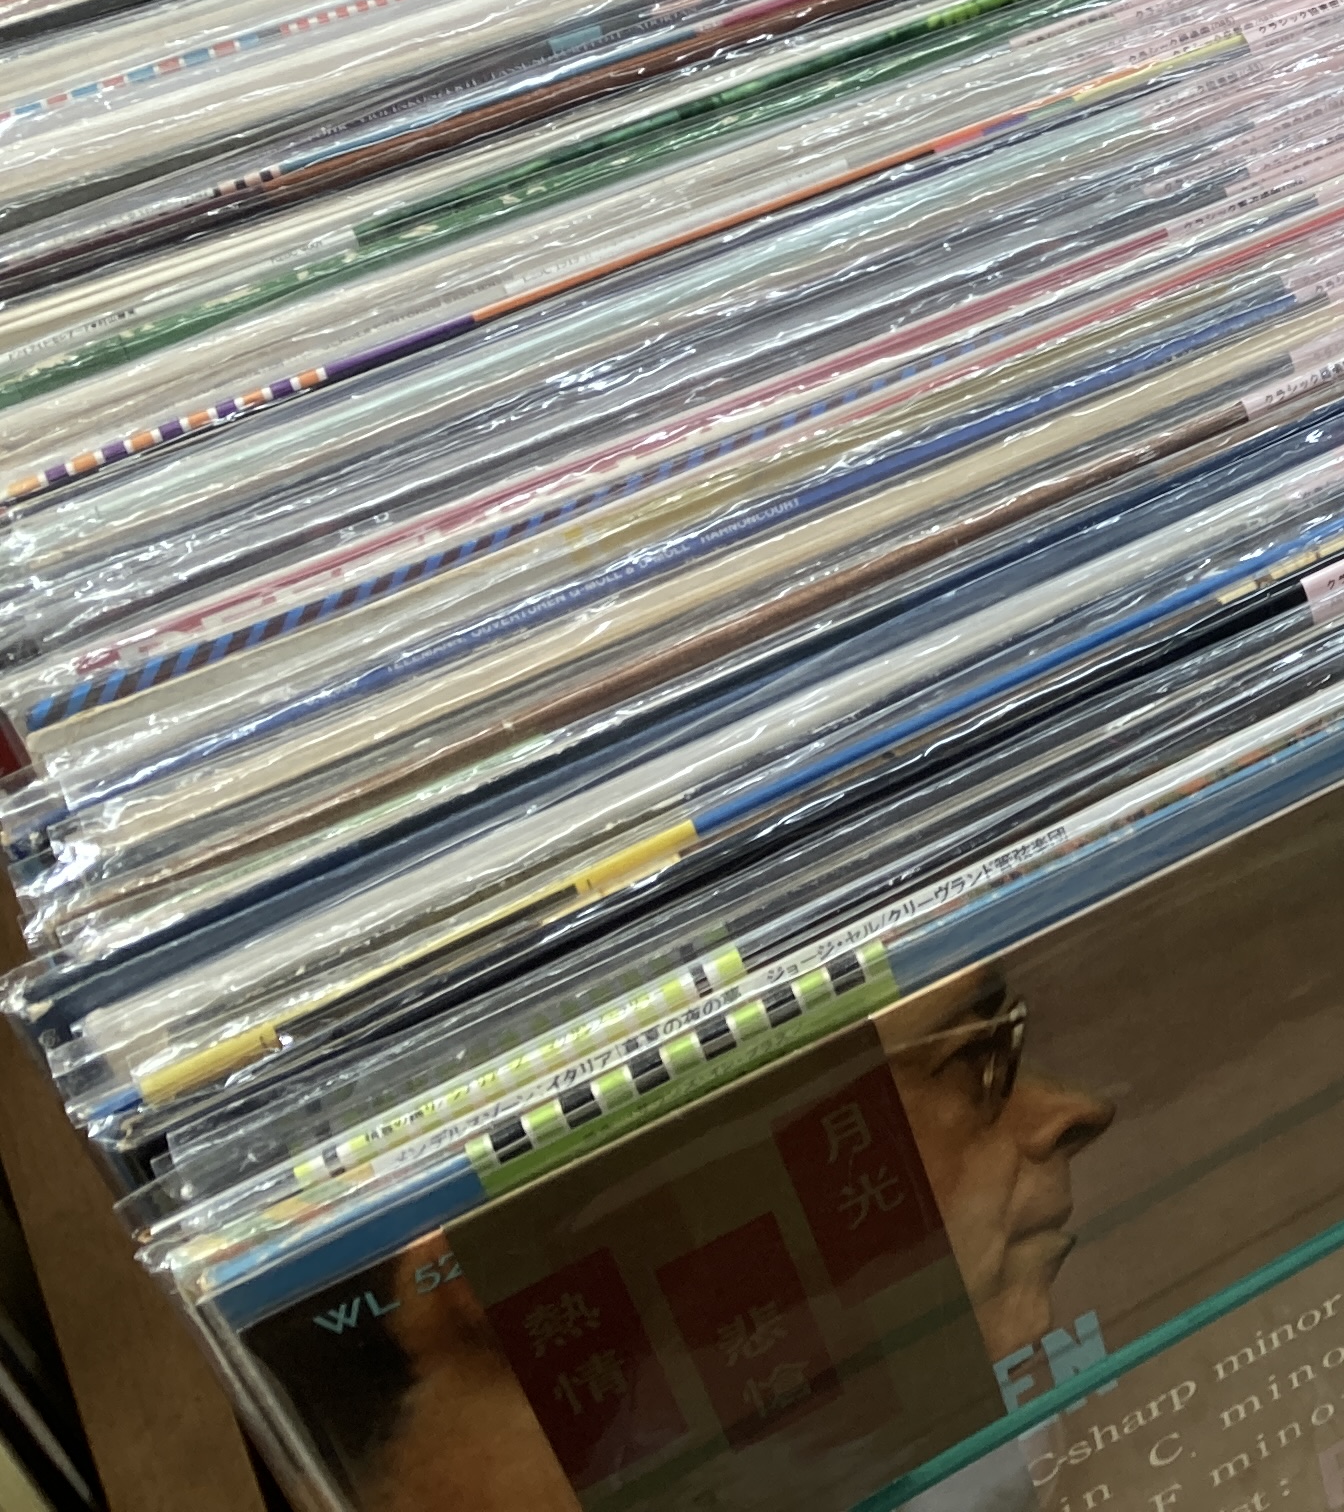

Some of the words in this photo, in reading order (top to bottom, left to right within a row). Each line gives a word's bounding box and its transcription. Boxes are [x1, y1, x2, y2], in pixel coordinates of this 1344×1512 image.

[820, 1099, 904, 1232] 月光
[313, 1289, 402, 1335] WL
[1027, 1379, 1199, 1487] C-sharp
